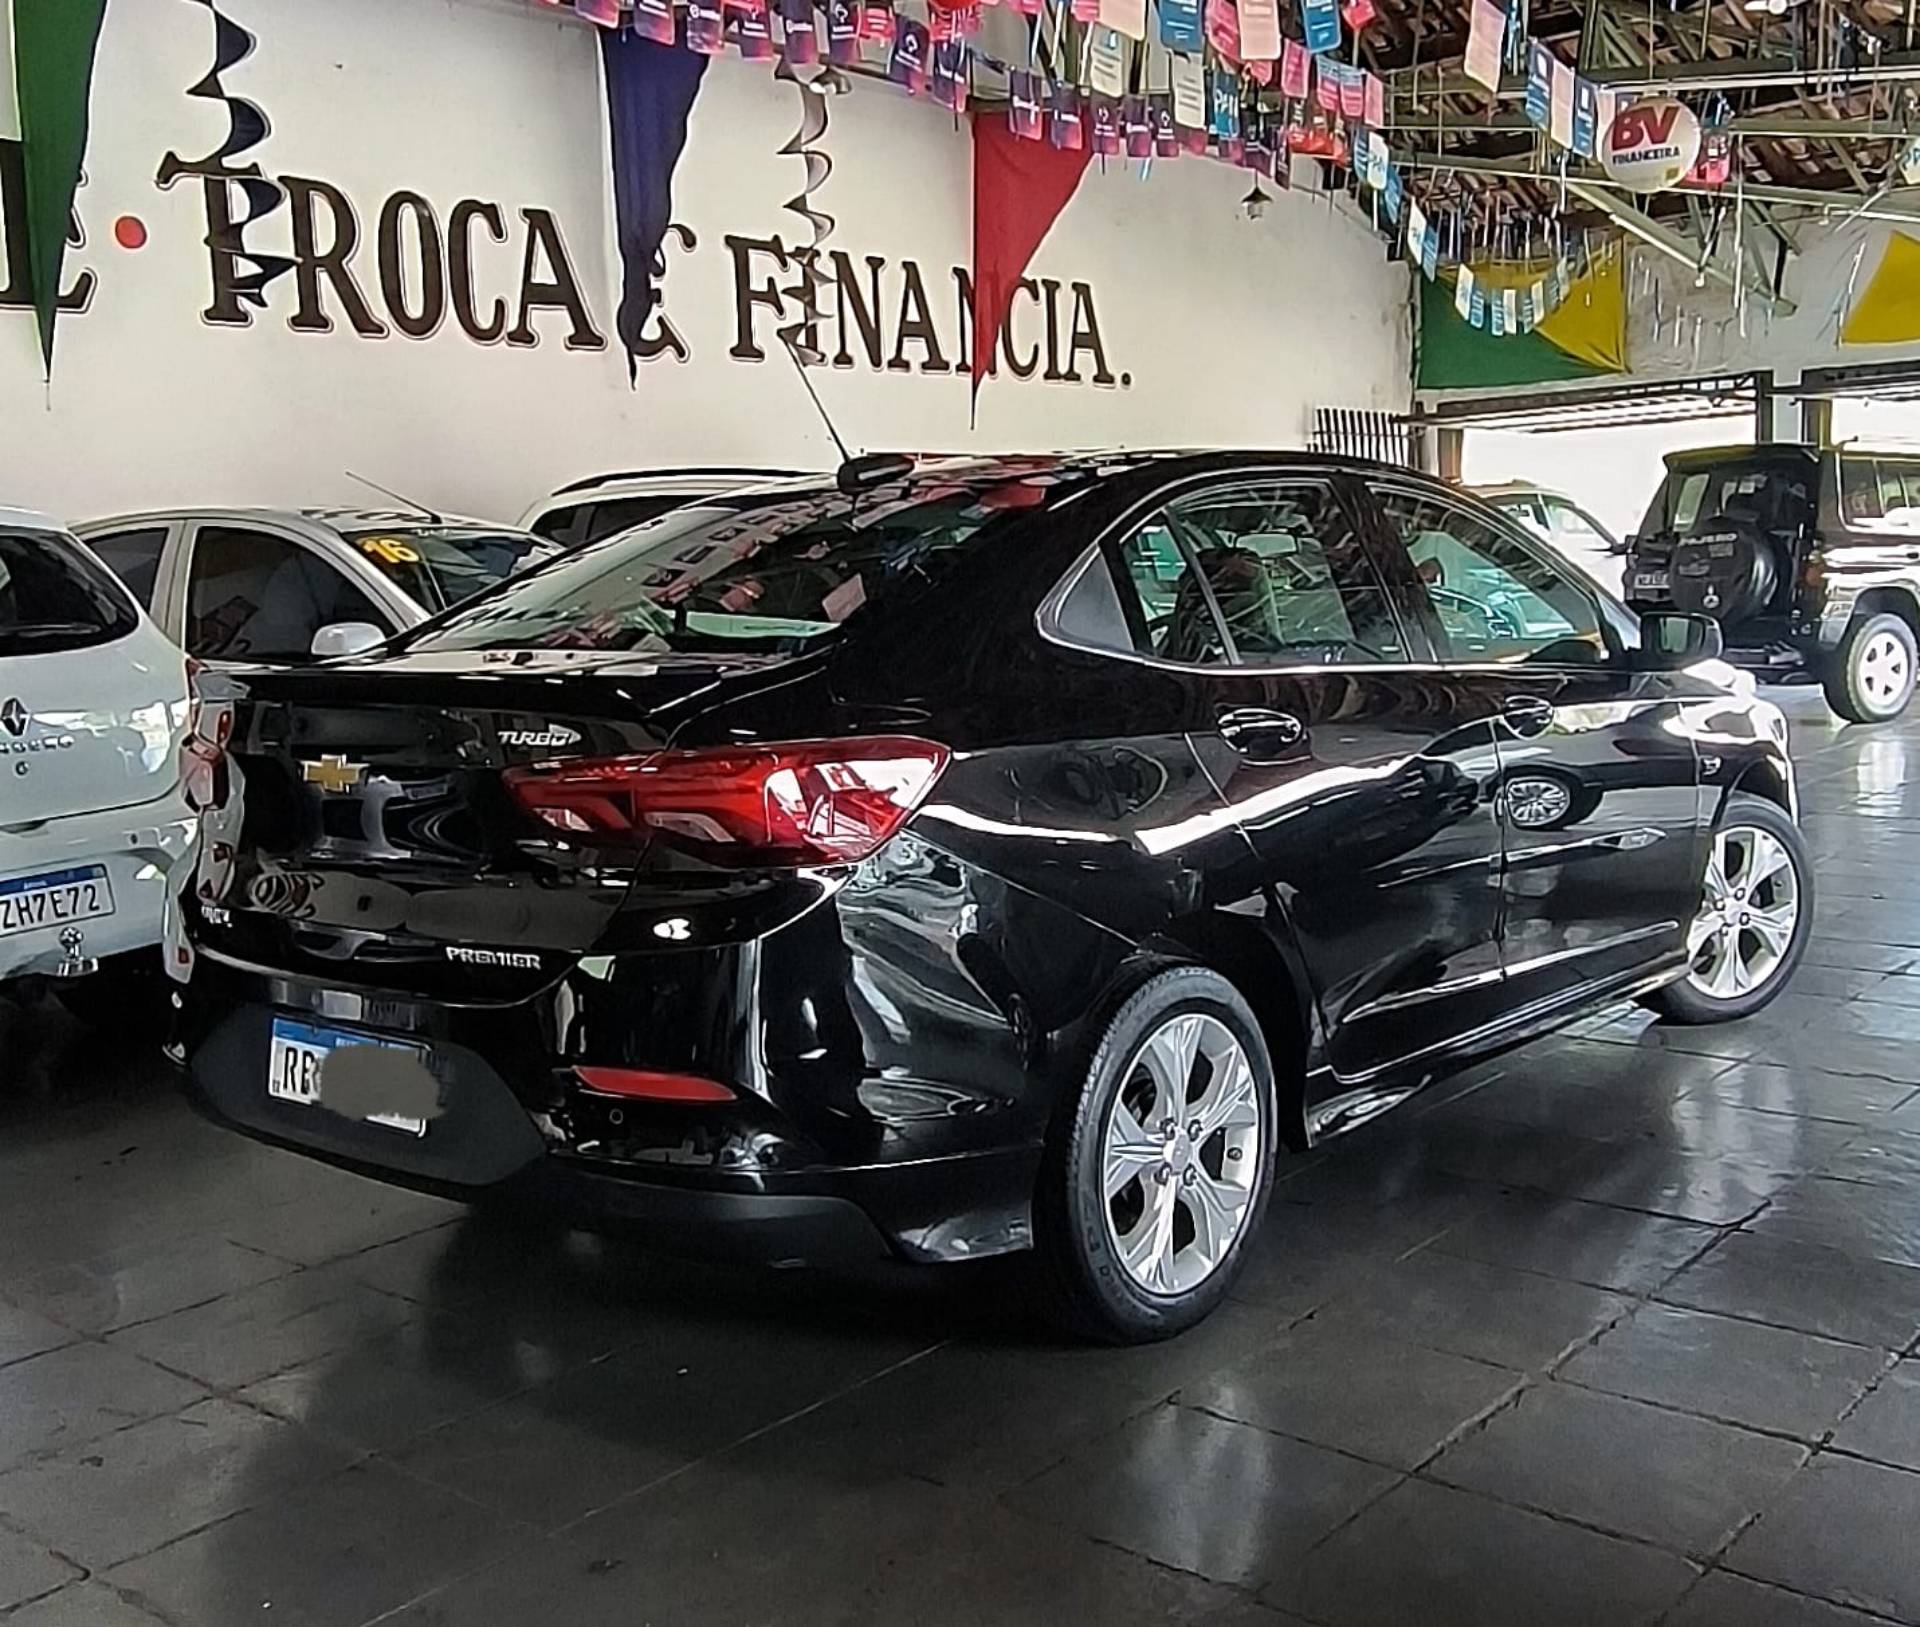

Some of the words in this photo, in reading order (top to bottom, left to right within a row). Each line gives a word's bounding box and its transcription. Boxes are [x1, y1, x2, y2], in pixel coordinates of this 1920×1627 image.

[1612, 106, 1681, 151] BV
[498, 730, 571, 747] TURBO
[445, 946, 542, 971] PREMIER
